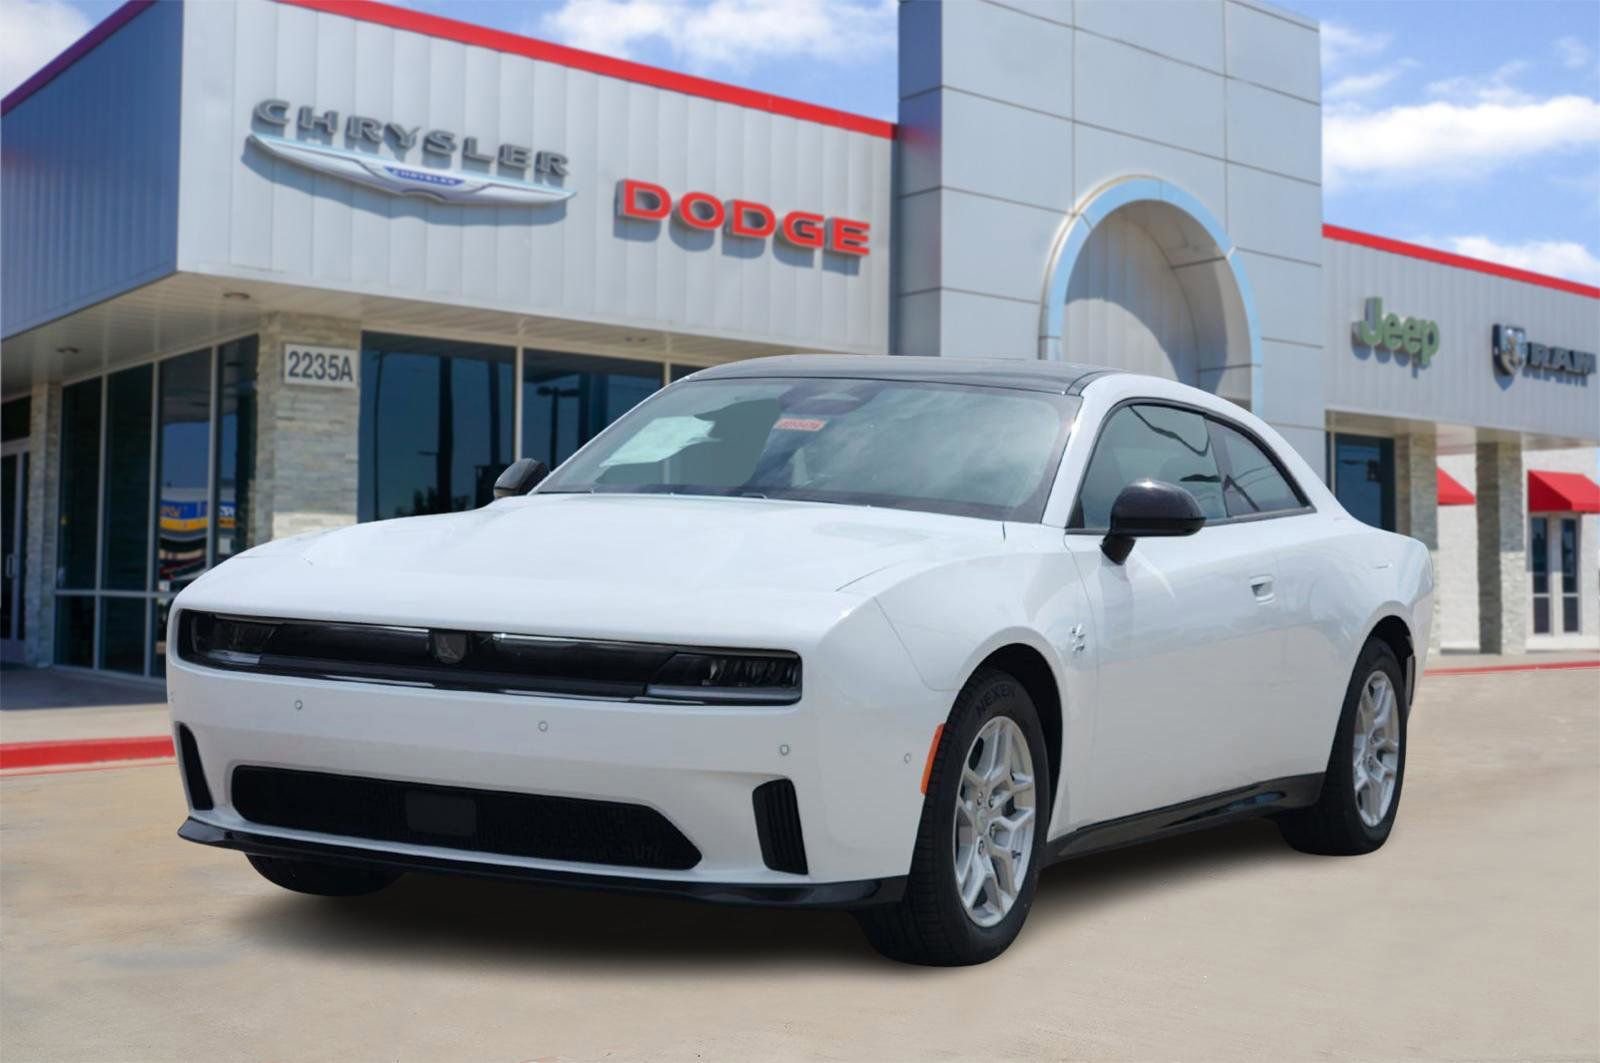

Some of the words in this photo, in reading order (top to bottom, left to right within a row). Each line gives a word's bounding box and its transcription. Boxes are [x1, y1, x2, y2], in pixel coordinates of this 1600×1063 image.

[252, 98, 569, 177] CHRYSLER
[615, 178, 871, 256] DODGE
[288, 350, 353, 382] 2235A
[1352, 296, 1440, 367] Jeep
[1527, 342, 1597, 377] RAM
